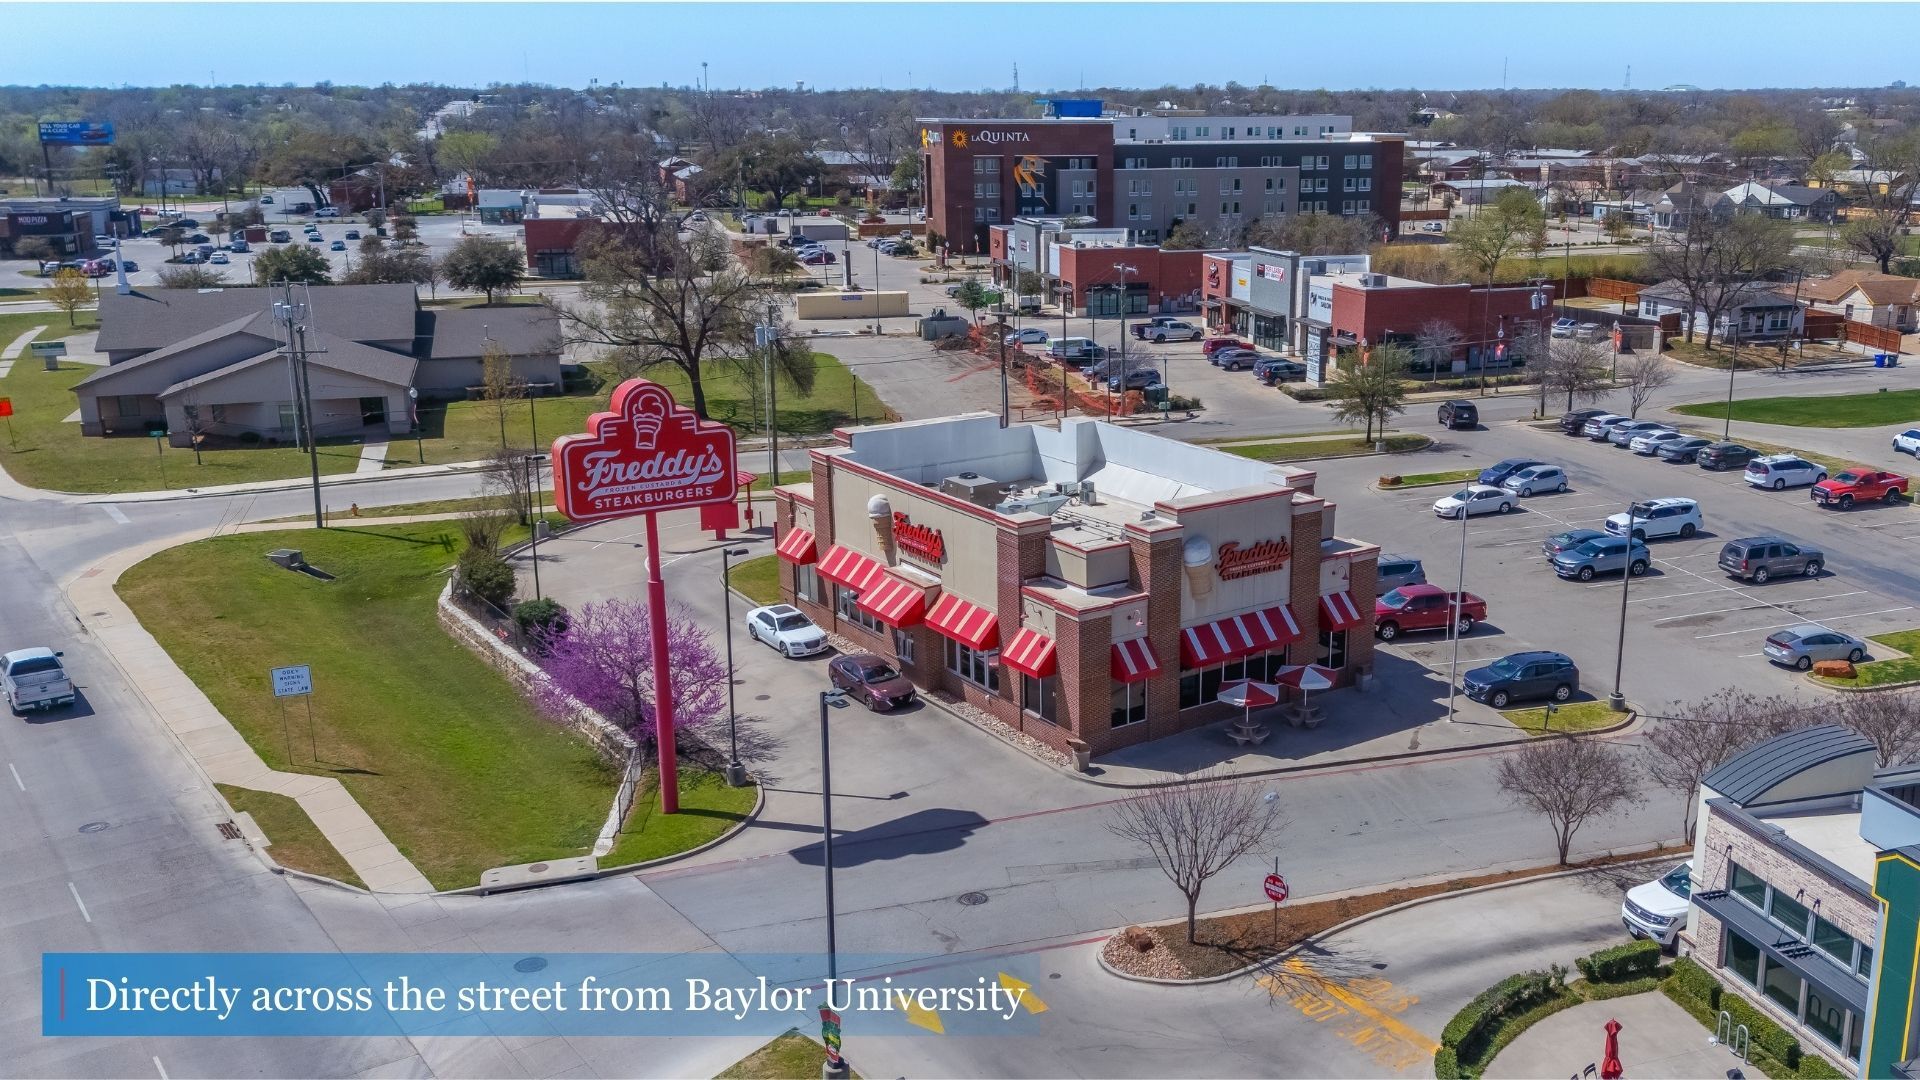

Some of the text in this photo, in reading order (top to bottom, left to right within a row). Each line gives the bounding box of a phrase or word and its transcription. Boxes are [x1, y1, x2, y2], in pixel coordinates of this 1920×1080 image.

[578, 443, 724, 492] Freddy's
[595, 486, 713, 509] STEAKBURGERS
[604, 485, 636, 494] FROZEN
[640, 480, 675, 490] CUSTARD
